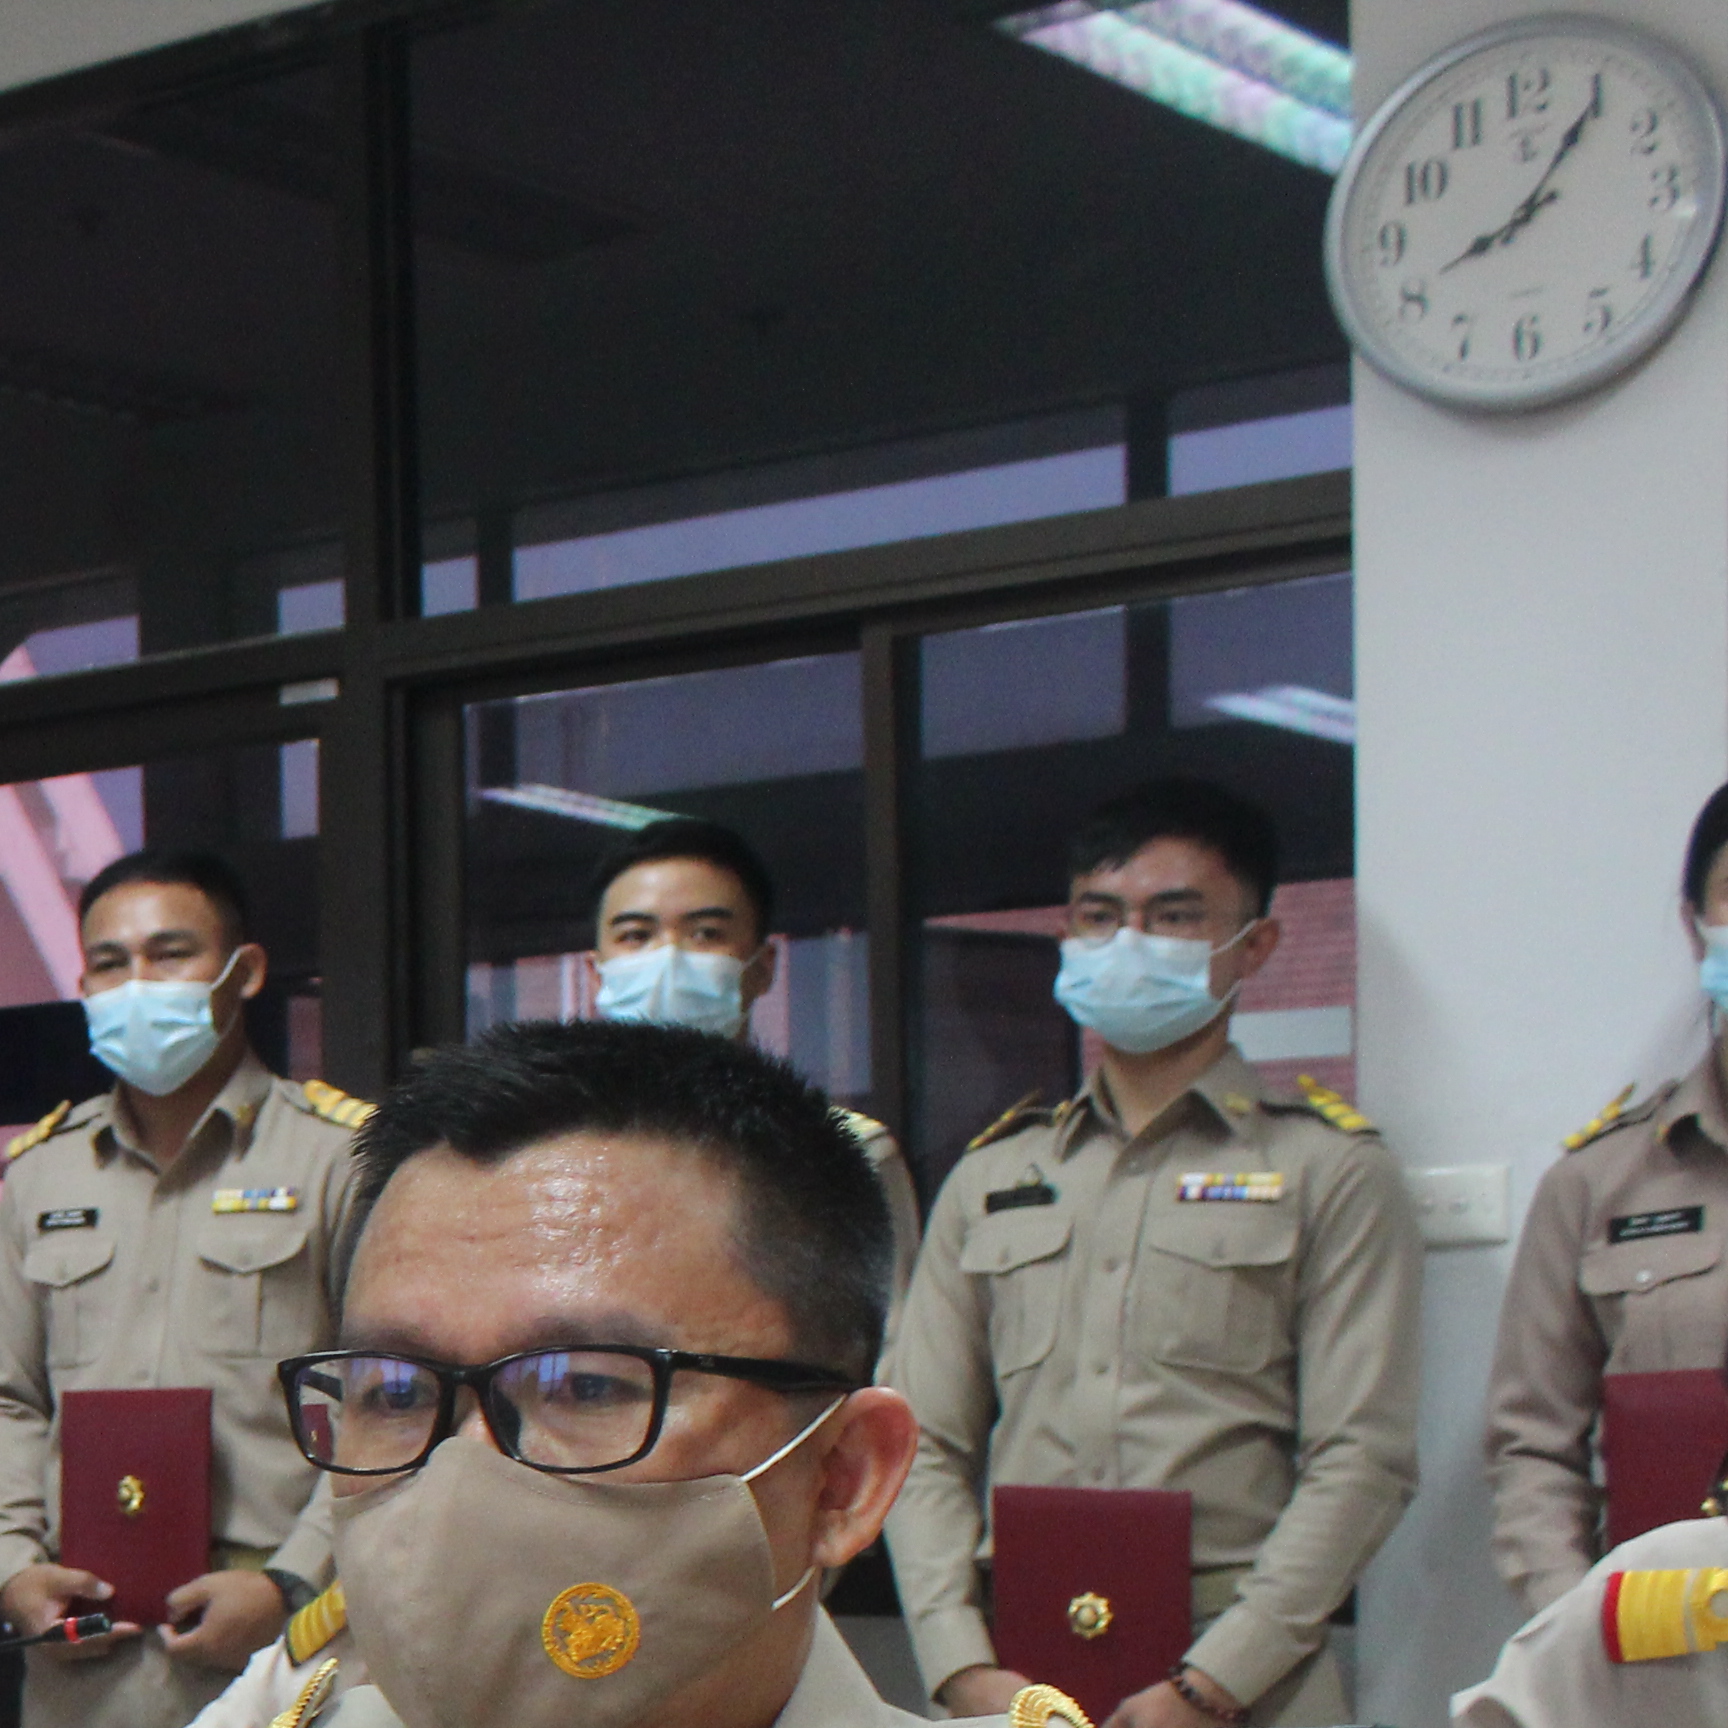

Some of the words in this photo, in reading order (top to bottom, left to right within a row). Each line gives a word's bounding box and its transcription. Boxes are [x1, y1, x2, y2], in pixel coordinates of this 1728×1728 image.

[1505, 69, 1550, 118] 12
[1451, 98, 1485, 150] 11
[1630, 109, 1661, 156] 2
[1406, 158, 1449, 206] 10
[1649, 166, 1681, 212] 3
[1380, 222, 1407, 268] 9
[1632, 232, 1655, 280] 4
[1400, 280, 1430, 322] 8
[1584, 288, 1612, 333] 5
[1450, 314, 1475, 362] 7
[1513, 316, 1542, 361] 6
